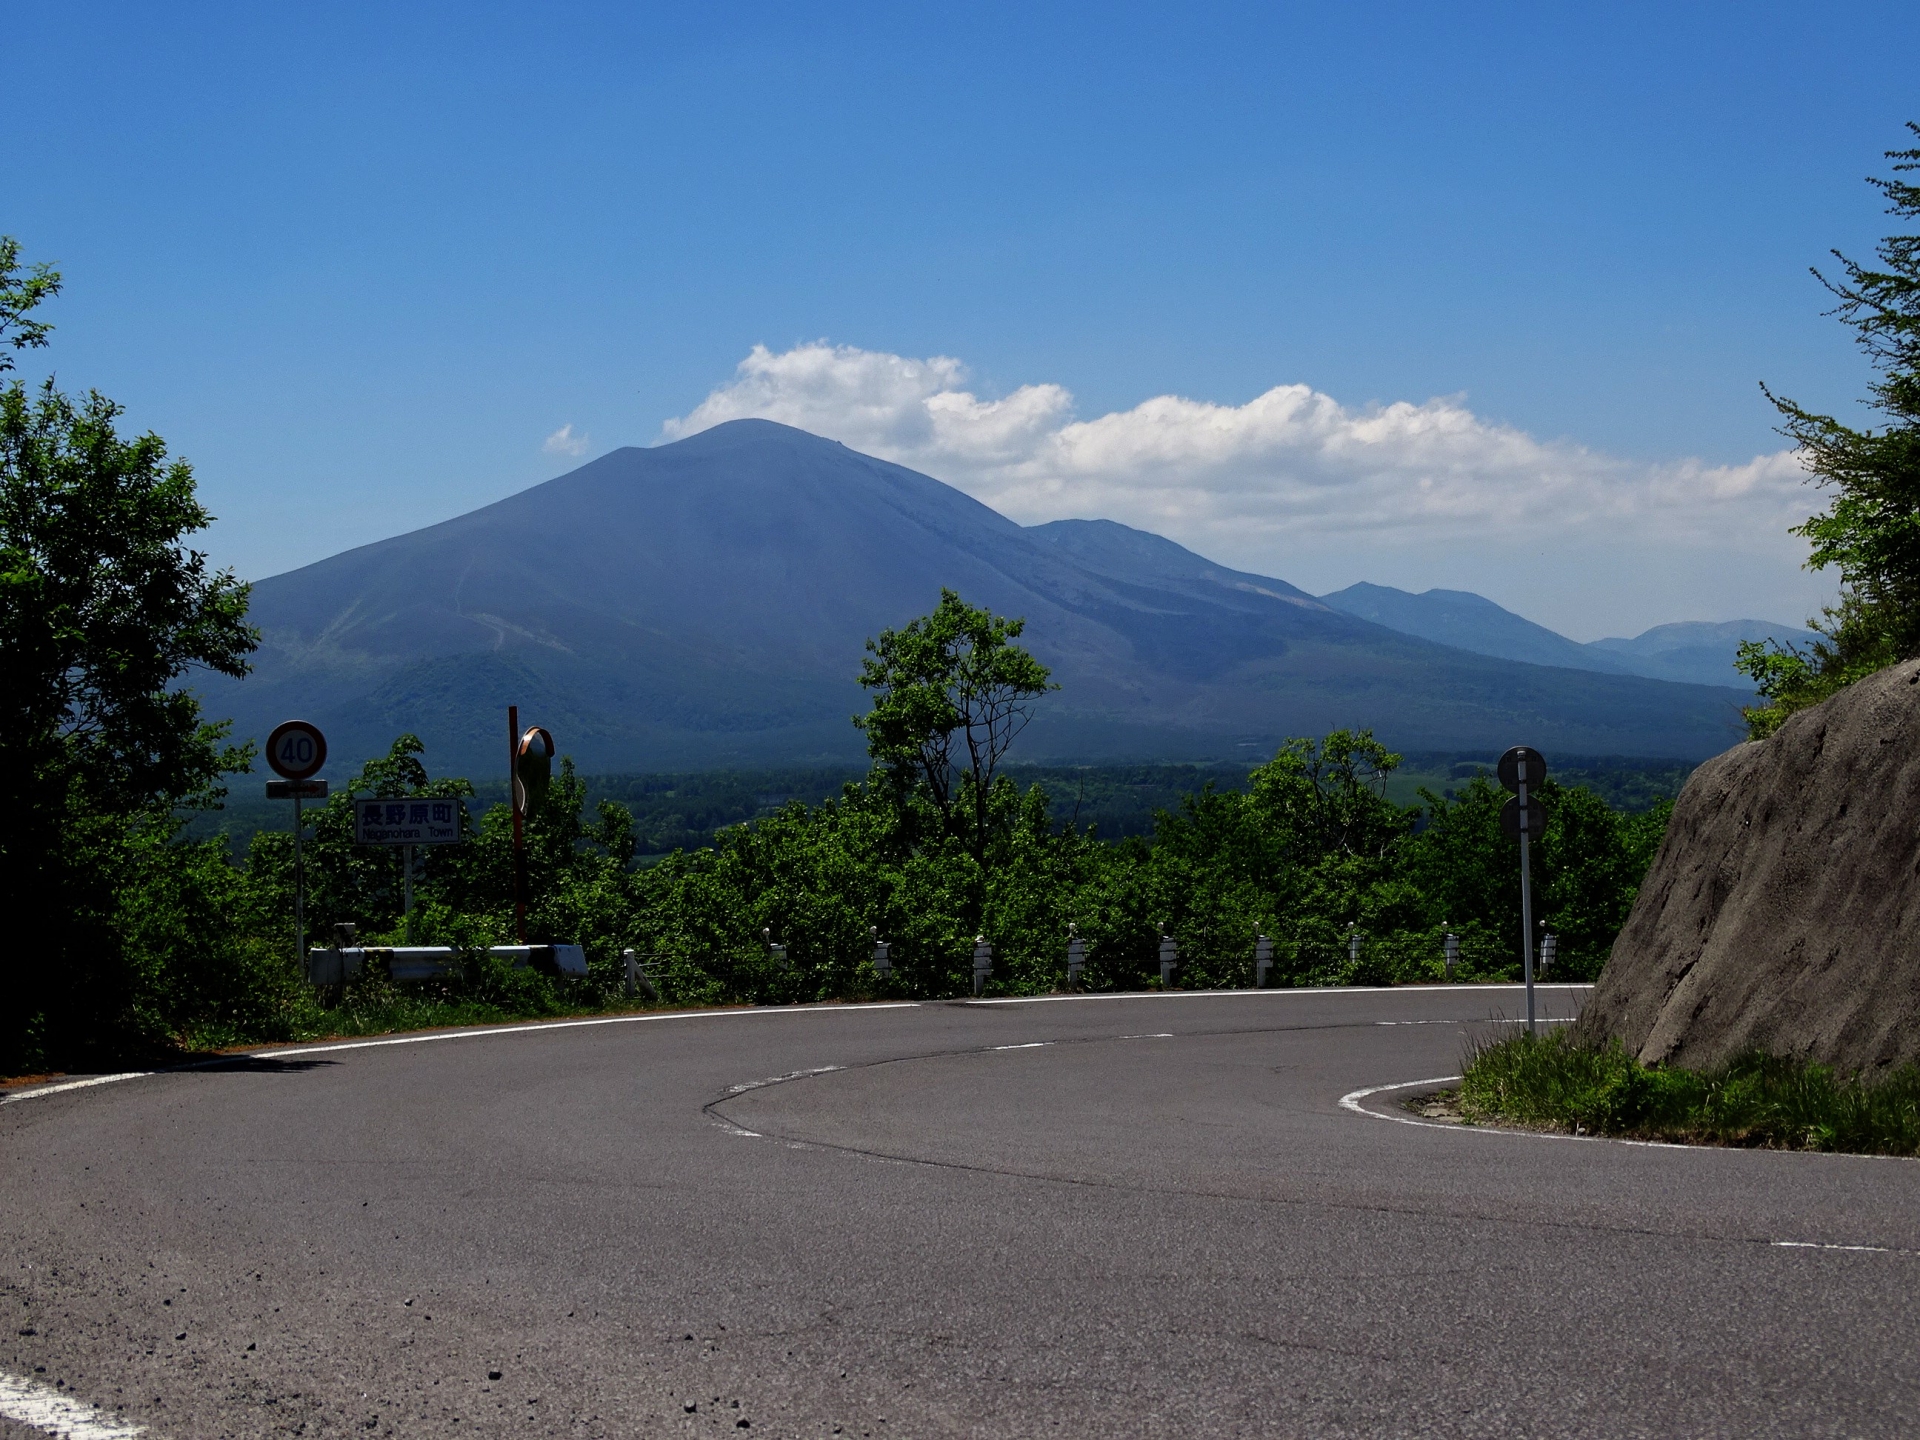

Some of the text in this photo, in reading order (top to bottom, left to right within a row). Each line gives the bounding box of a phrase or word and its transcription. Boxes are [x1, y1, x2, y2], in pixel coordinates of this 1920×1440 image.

[281, 738, 312, 763] 40
[362, 803, 452, 826] 長野原町
[362, 827, 453, 841] Naganohara Town
